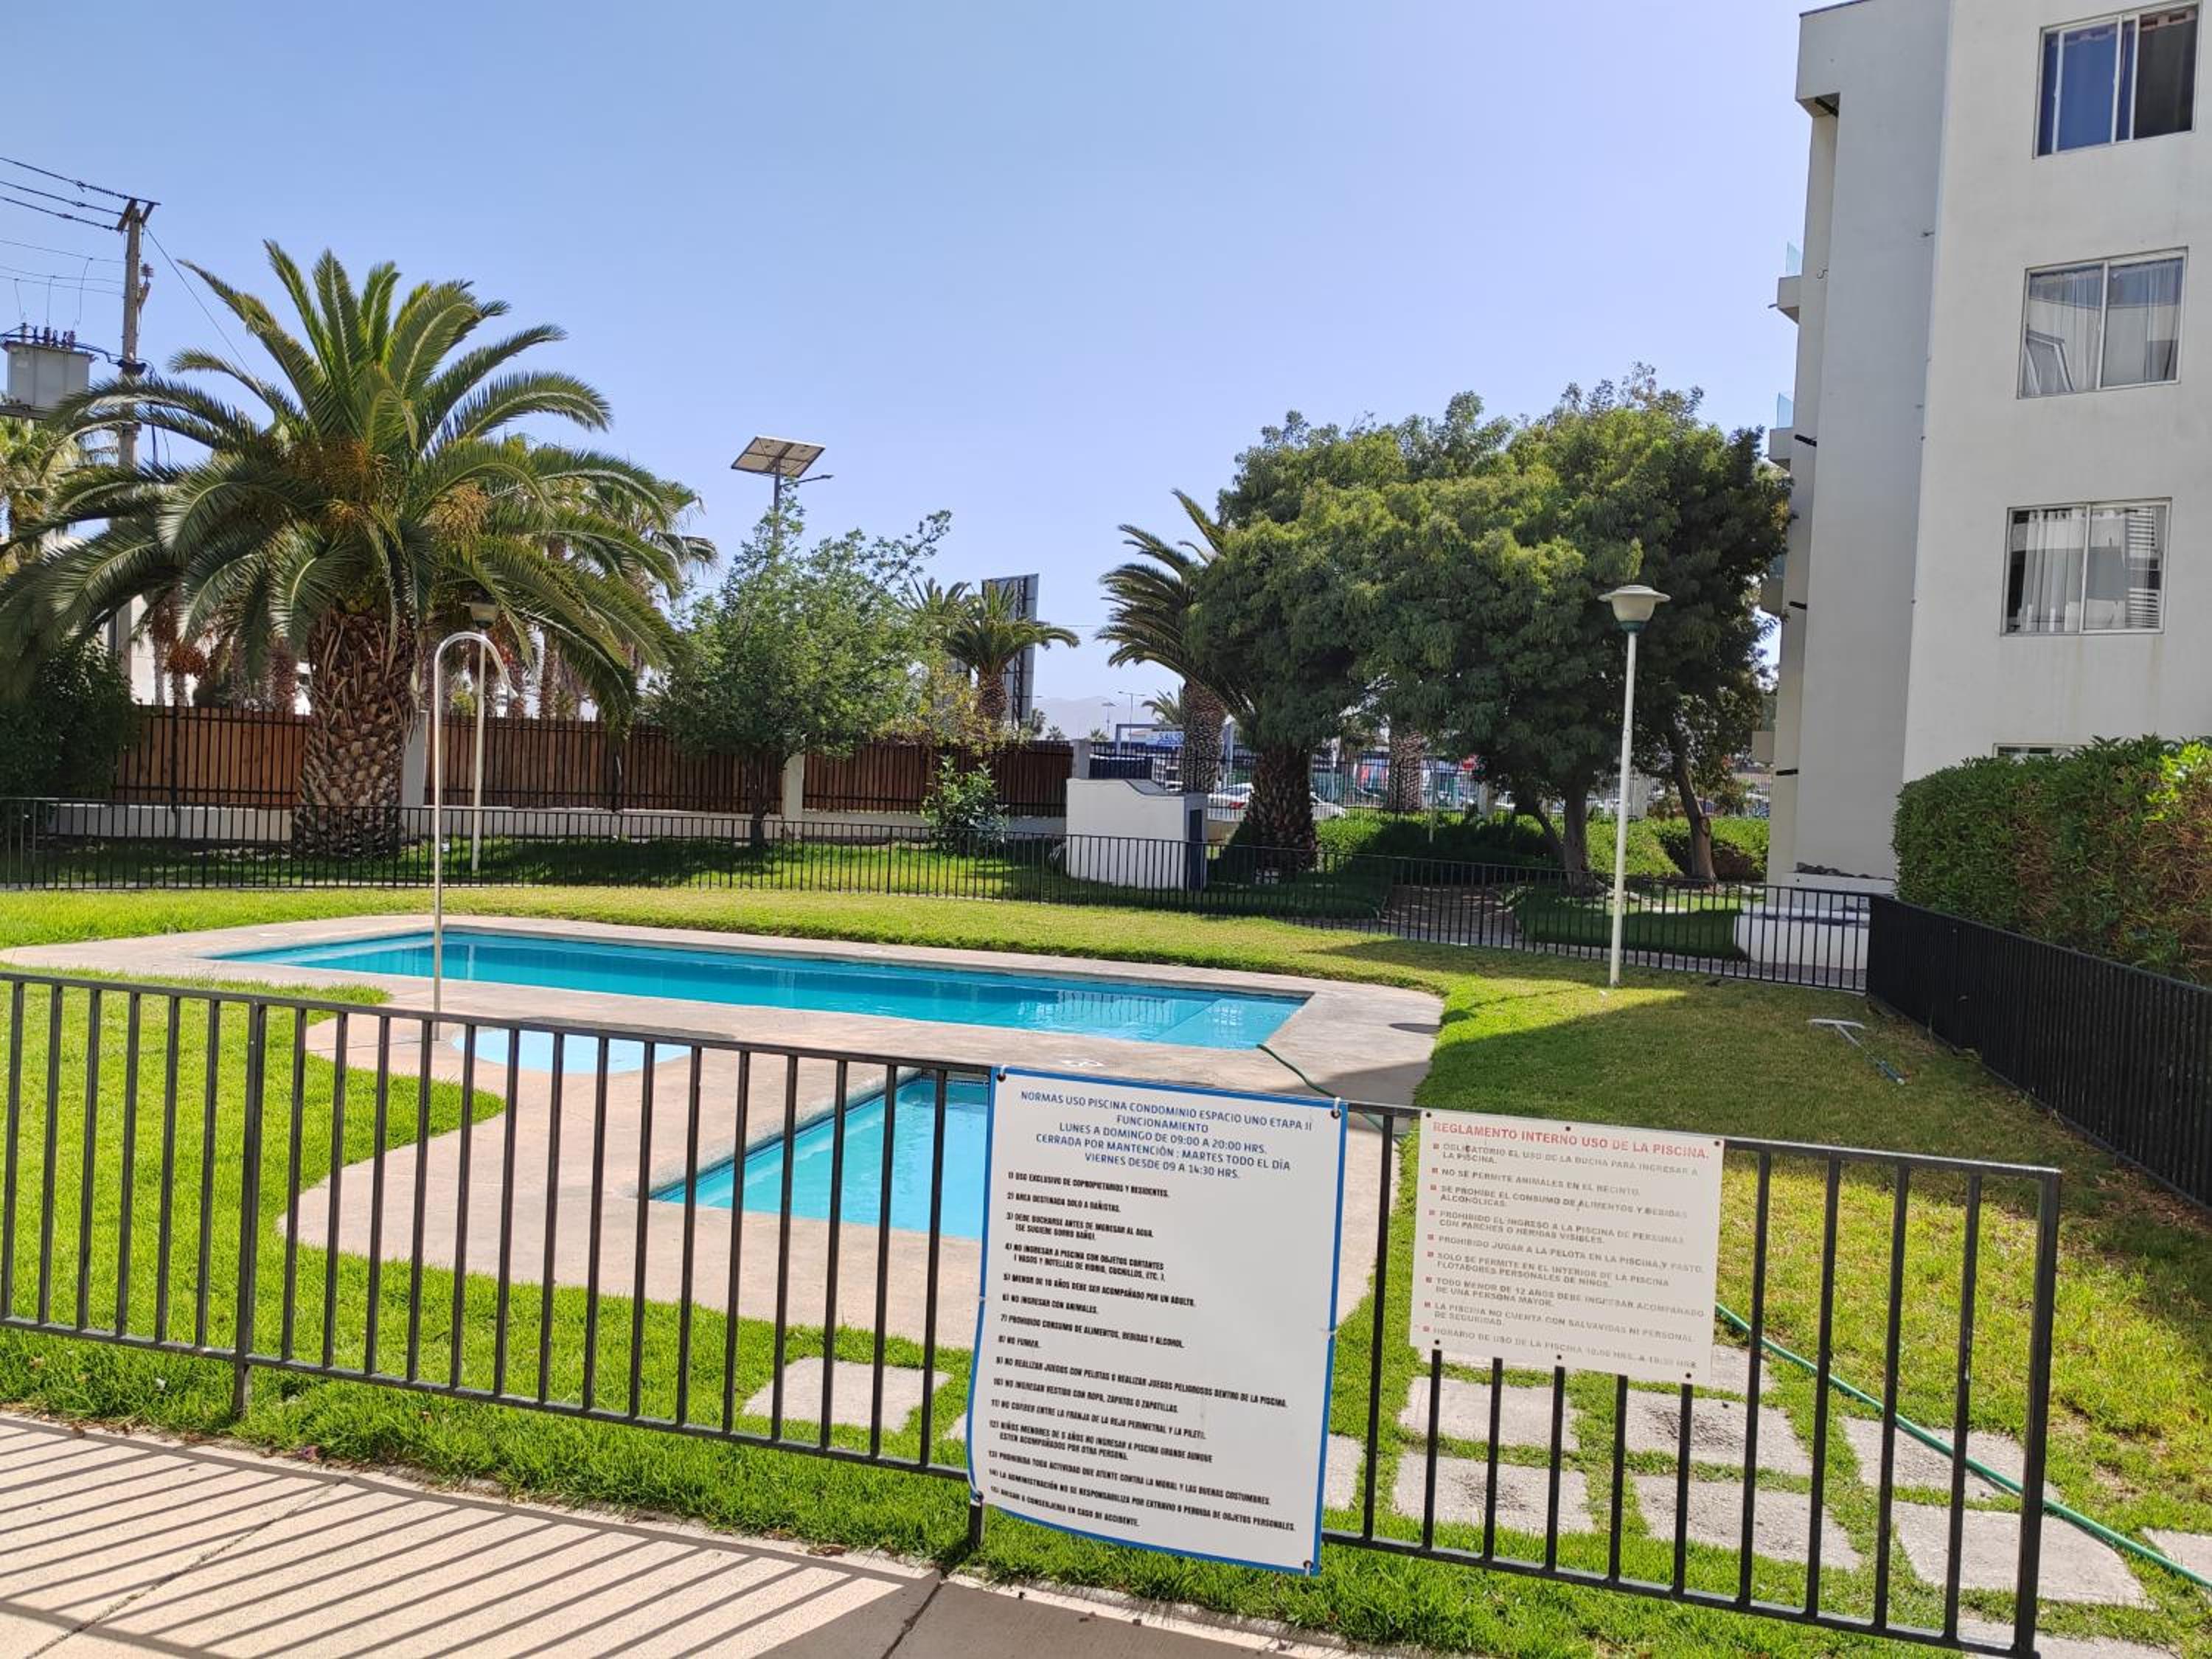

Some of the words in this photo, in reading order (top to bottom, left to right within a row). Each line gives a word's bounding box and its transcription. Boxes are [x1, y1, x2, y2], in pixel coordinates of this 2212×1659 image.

[1021, 1091, 1063, 1104] NORMAS
[1065, 1095, 1085, 1106] USO
[1088, 1097, 1127, 1110] PISCINA
[1129, 1102, 1196, 1118] CONDOMINIO
[1200, 1110, 1242, 1123] ESPACIO
[1244, 1114, 1267, 1126] UNO
[1270, 1117, 1302, 1130] ETAPA
[1305, 1121, 1312, 1130] II
[1116, 1114, 1208, 1133] FUNCIONAMIENTO
[1036, 1133, 1082, 1147] CERRADA
[1085, 1138, 1104, 1149] POR
[1107, 1141, 1174, 1157] MANTENCIÓN
[1182, 1149, 1223, 1163] MARTES
[1225, 1154, 1254, 1166] TODO
[1257, 1158, 1269, 1168] EL
[1272, 1158, 1290, 1170] DÍA
[1060, 1121, 1091, 1134] LUNES
[1093, 1125, 1100, 1135] A
[1103, 1127, 1152, 1141] DOMINGO
[1155, 1132, 1168, 1143] DE
[1170, 1134, 1199, 1146] 09:00
[1202, 1137, 1209, 1147] A
[1212, 1138, 1241, 1151] 20:00
[1244, 1142, 1267, 1153] HRS.
[1433, 1121, 1517, 1139] REGLAMENTO
[1522, 1130, 1576, 1145] INTERNO
[1582, 1136, 1608, 1148] USO
[1613, 1139, 1629, 1151] DE
[1633, 1142, 1648, 1153] LA
[1652, 1144, 1709, 1158] PISCINA.
[1085, 1152, 1126, 1165] VIERNES
[1128, 1157, 1160, 1169] DESDE
[1163, 1161, 1175, 1171] 09
[1178, 1162, 1186, 1172] A
[1189, 1164, 1215, 1175] 14:30
[1217, 1166, 1239, 1178] HRS.
